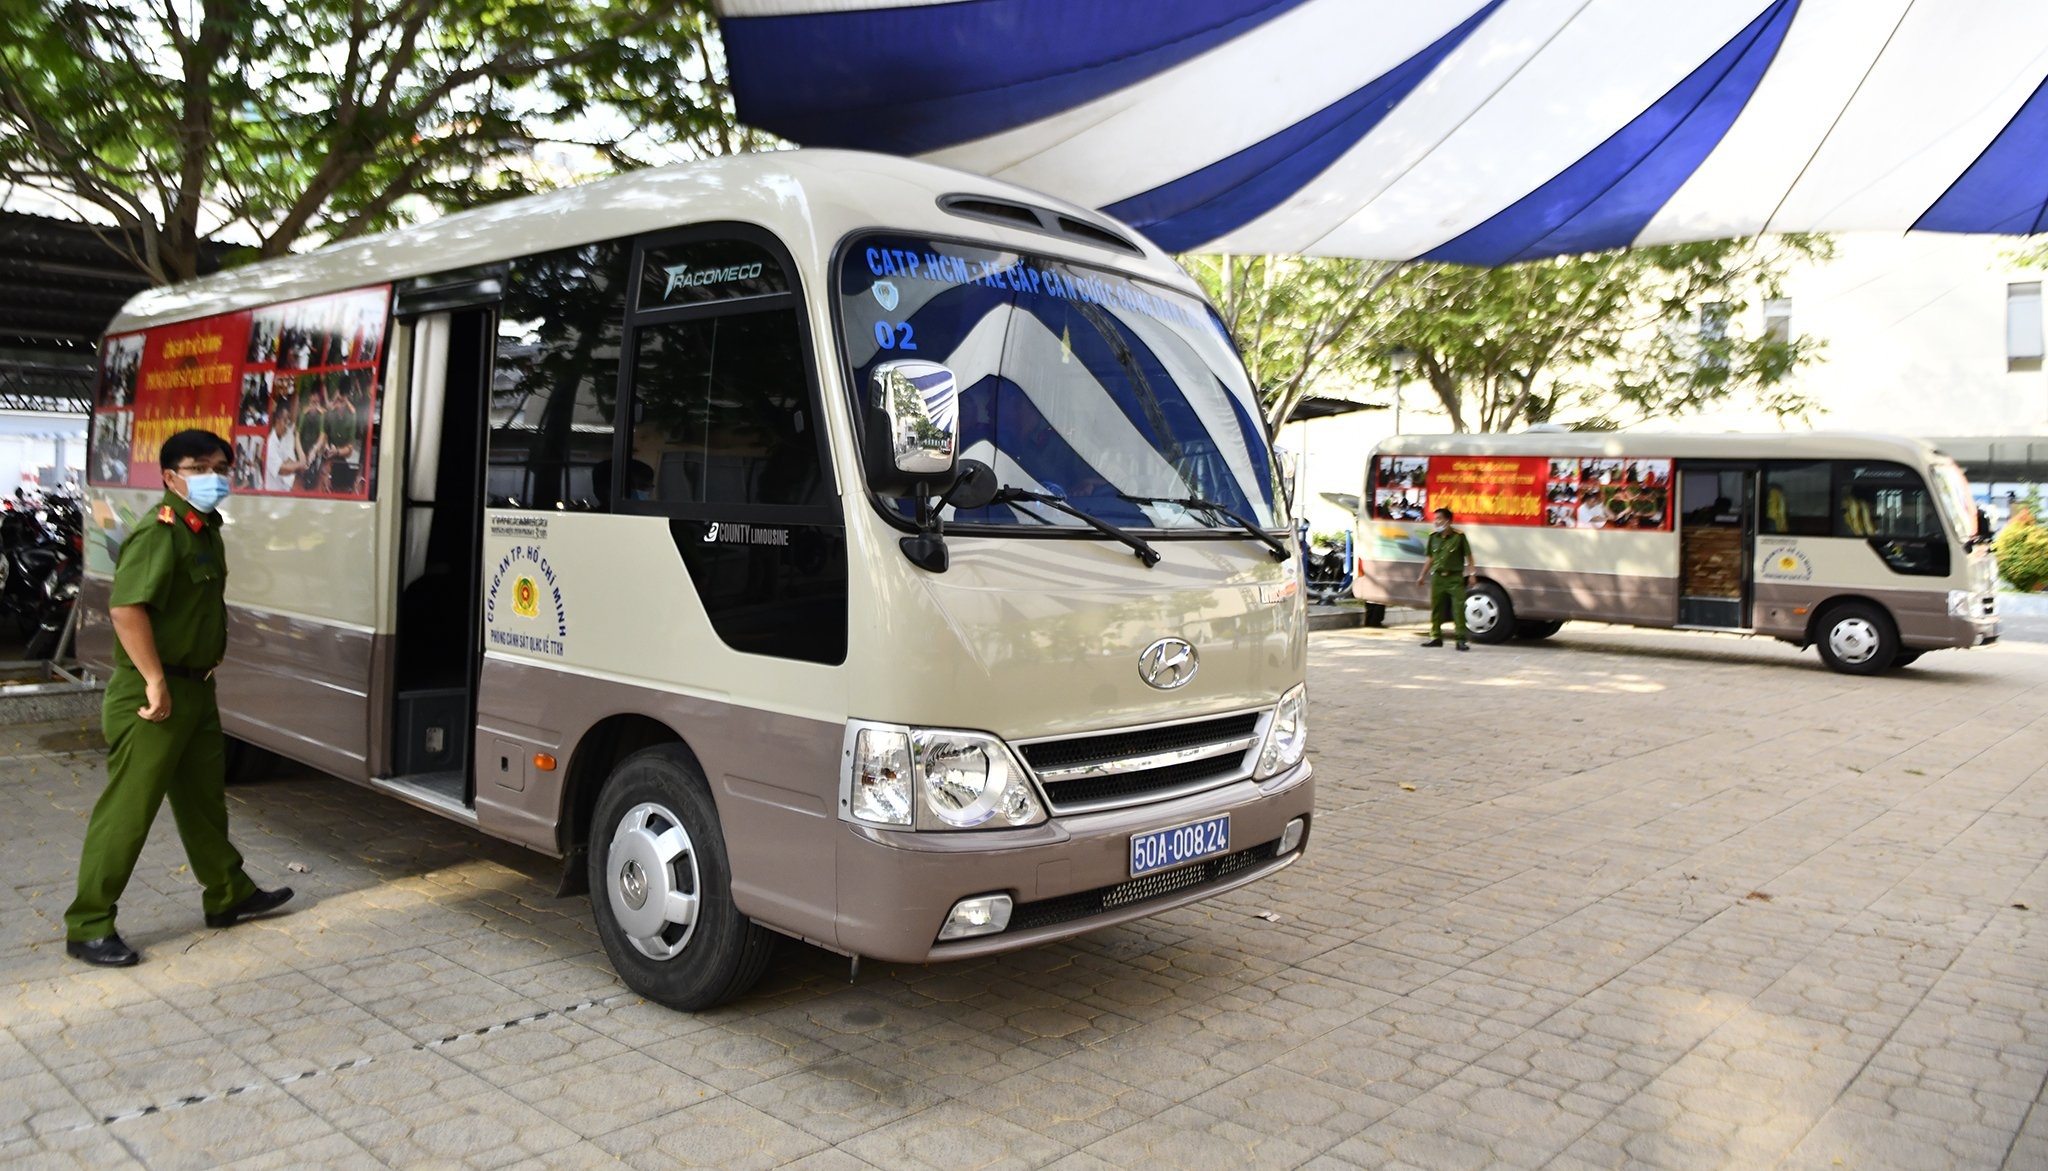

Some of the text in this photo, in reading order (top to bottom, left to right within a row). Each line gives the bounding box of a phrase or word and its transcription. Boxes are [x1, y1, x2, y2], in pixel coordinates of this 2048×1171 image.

[663, 262, 762, 301] TRACOMECO
[979, 261, 1007, 289] XE
[1006, 258, 1039, 294] CẤP
[1041, 269, 1077, 301] CĂN
[874, 320, 917, 350] 02
[719, 522, 750, 544] COUNTY
[751, 528, 789, 546] LIMOUSINE
[487, 575, 501, 622] CÔNG
[499, 555, 510, 577] AN
[541, 558, 557, 586] CHÍ
[553, 587, 566, 637] MINH
[1134, 819, 1227, 871] 50A-008.24
